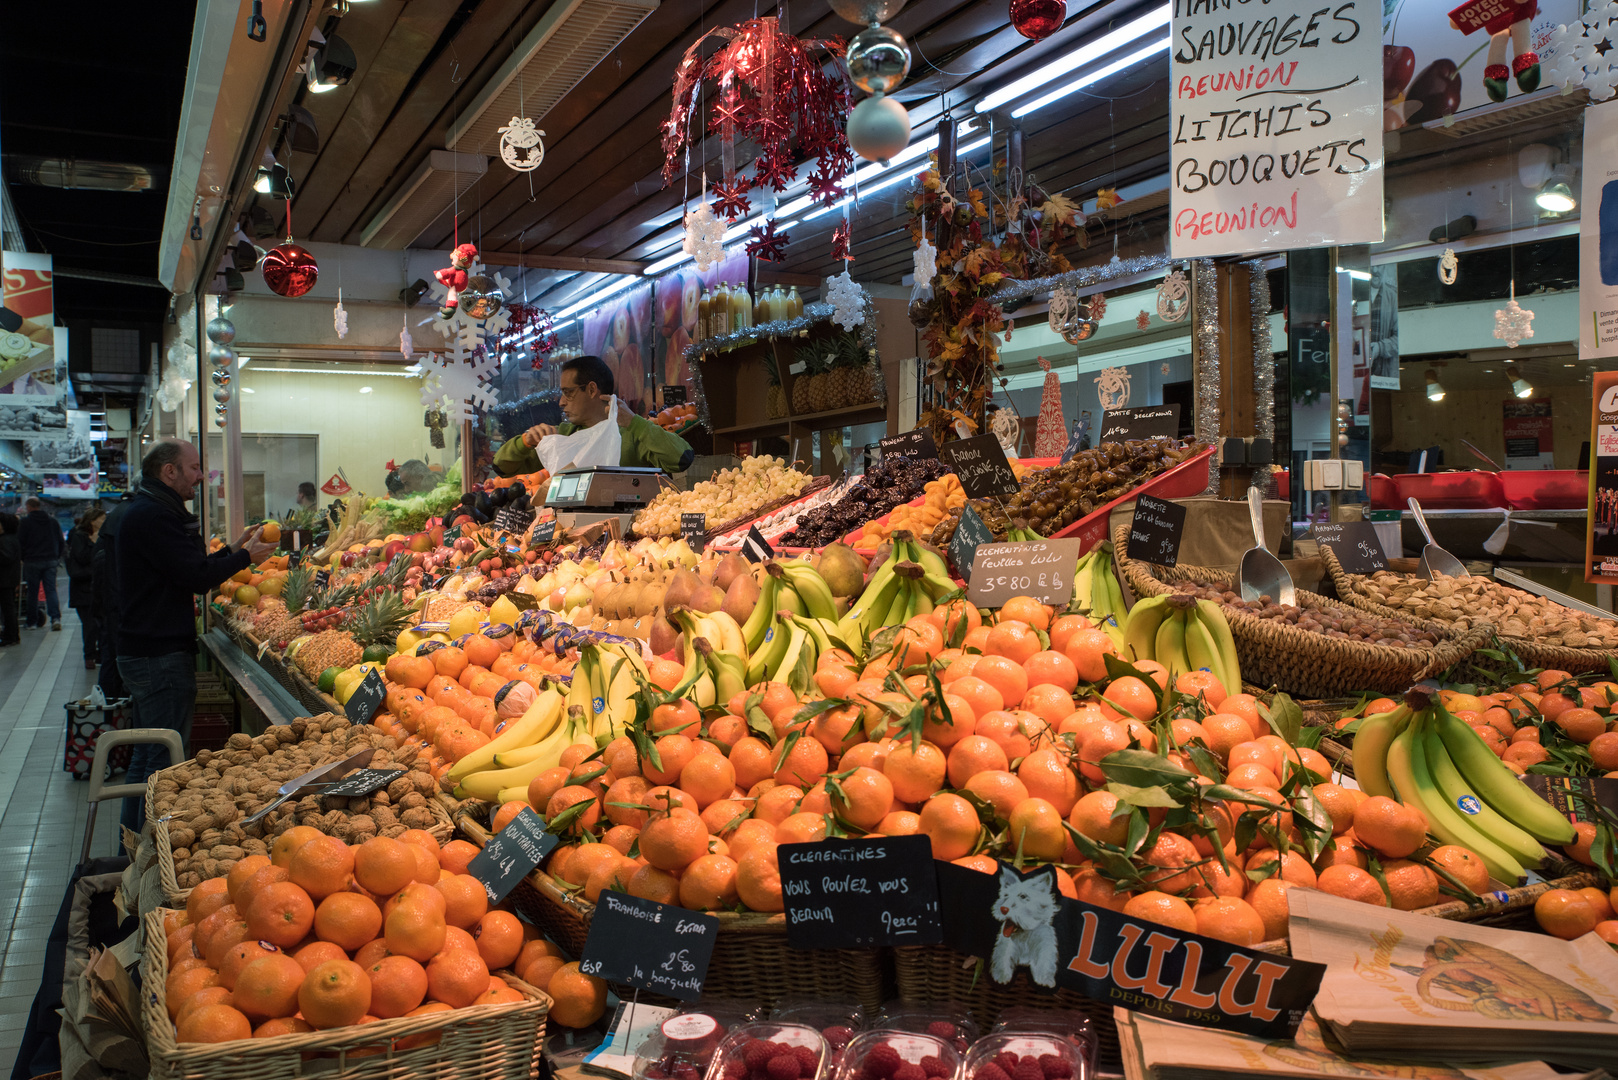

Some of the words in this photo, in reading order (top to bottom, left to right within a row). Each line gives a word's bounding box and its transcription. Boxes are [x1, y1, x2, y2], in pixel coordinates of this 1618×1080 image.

[1174, 3, 1360, 64] SAUVAGES
[1179, 60, 1298, 99] REUNION
[1173, 100, 1331, 145] LITCHIS
[1176, 138, 1370, 193] BOUQUETS
[1175, 191, 1298, 240] REUNION
[1108, 409, 1131, 417] DATTE
[976, 543, 1047, 556] CLEMENTINES
[980, 576, 1031, 592] 3€80
[505, 823, 522, 840] NON
[789, 847, 887, 864] CLEMENTINES
[784, 880, 811, 896] VOUS
[822, 874, 871, 894] POUVEZ
[878, 877, 909, 894] VOUS
[606, 896, 662, 923] FRAMBOISE
[675, 919, 706, 935] EXTRA
[790, 906, 834, 924] SERVIR
[582, 959, 603, 974] ESP
[661, 949, 695, 972] 2€80
[1067, 910, 1291, 1022] LULU
[1109, 987, 1173, 1014] DEPUIS
[1185, 1008, 1221, 1024] 1959
